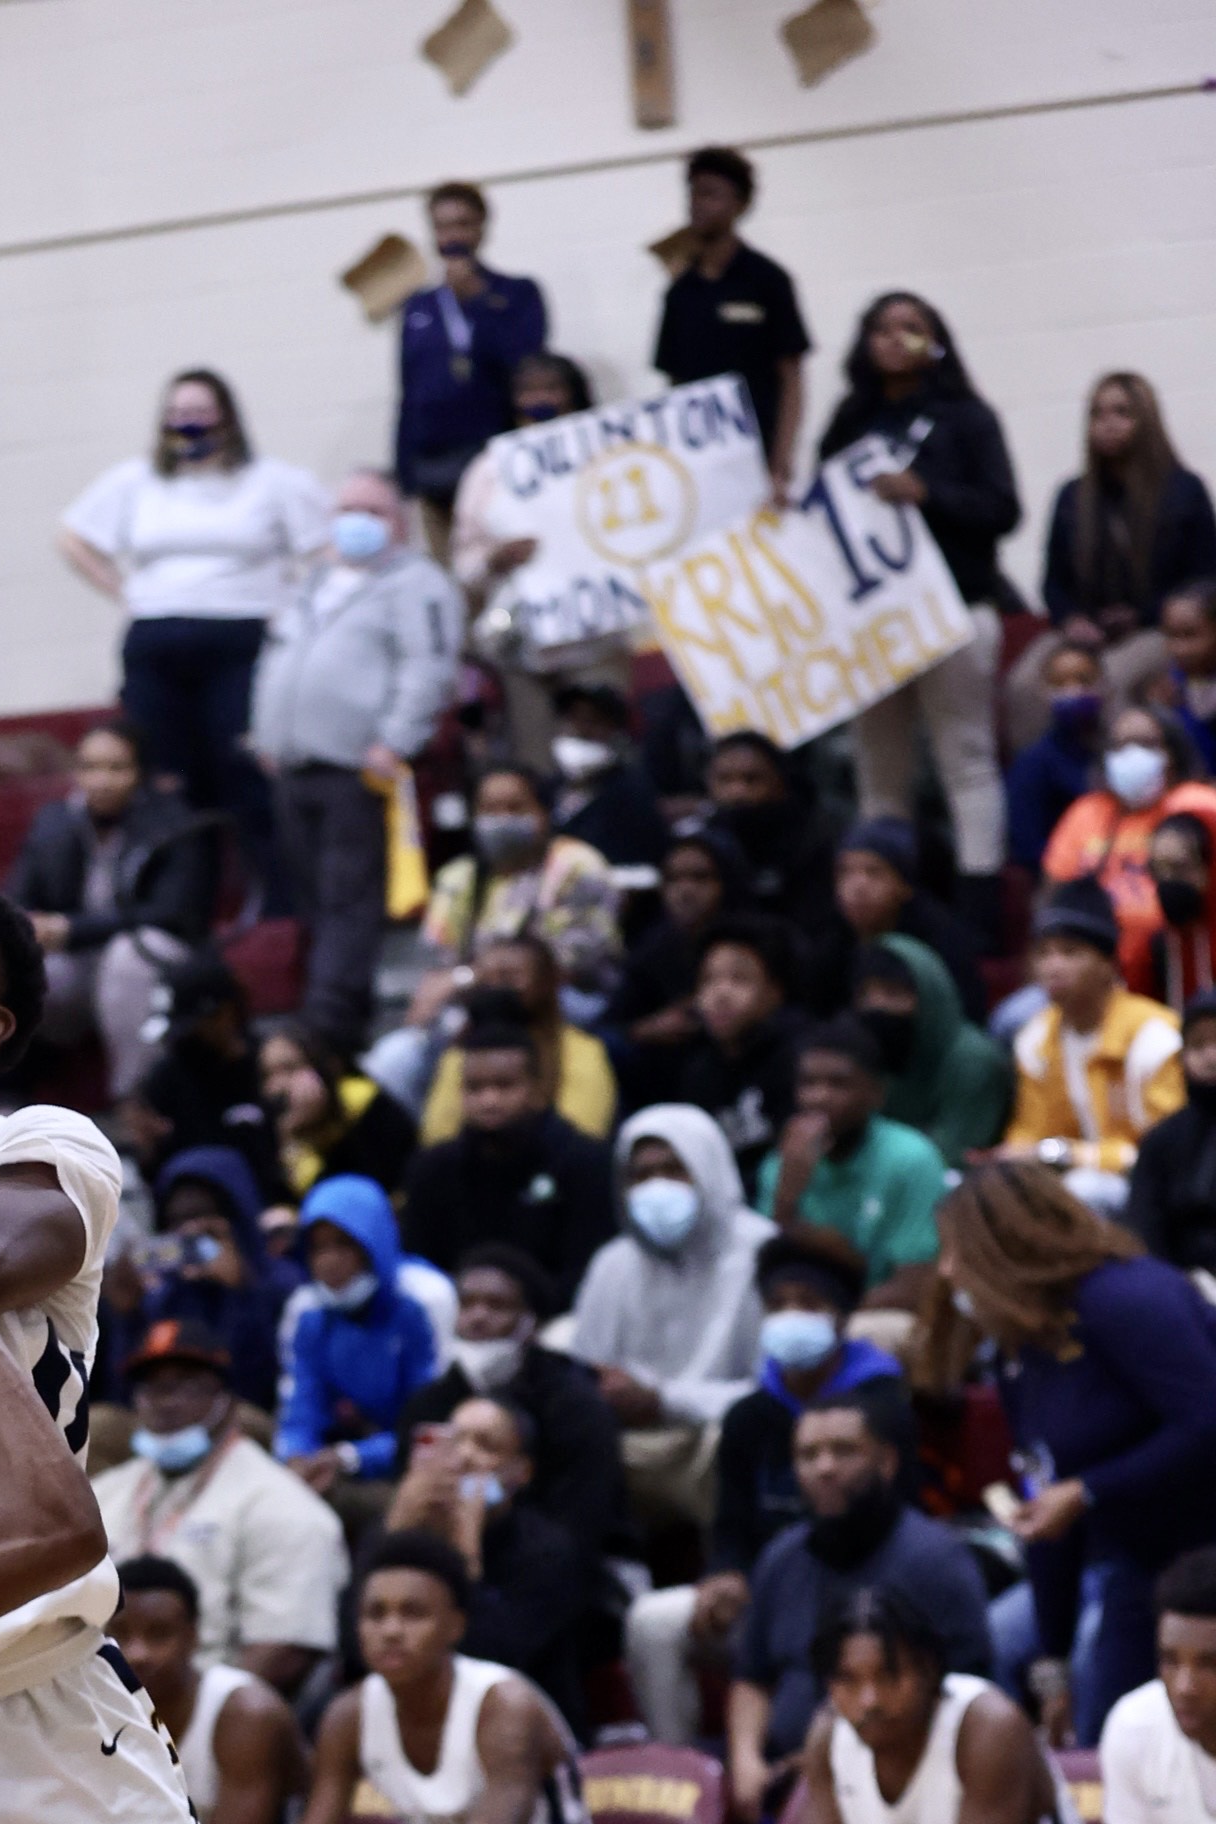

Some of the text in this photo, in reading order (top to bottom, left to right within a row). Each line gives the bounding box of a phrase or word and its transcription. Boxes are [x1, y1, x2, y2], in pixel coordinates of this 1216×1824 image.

[498, 380, 760, 498] QUINTON
[596, 463, 664, 532] 11
[800, 446, 914, 603] 15
[640, 506, 825, 704] KRIS
